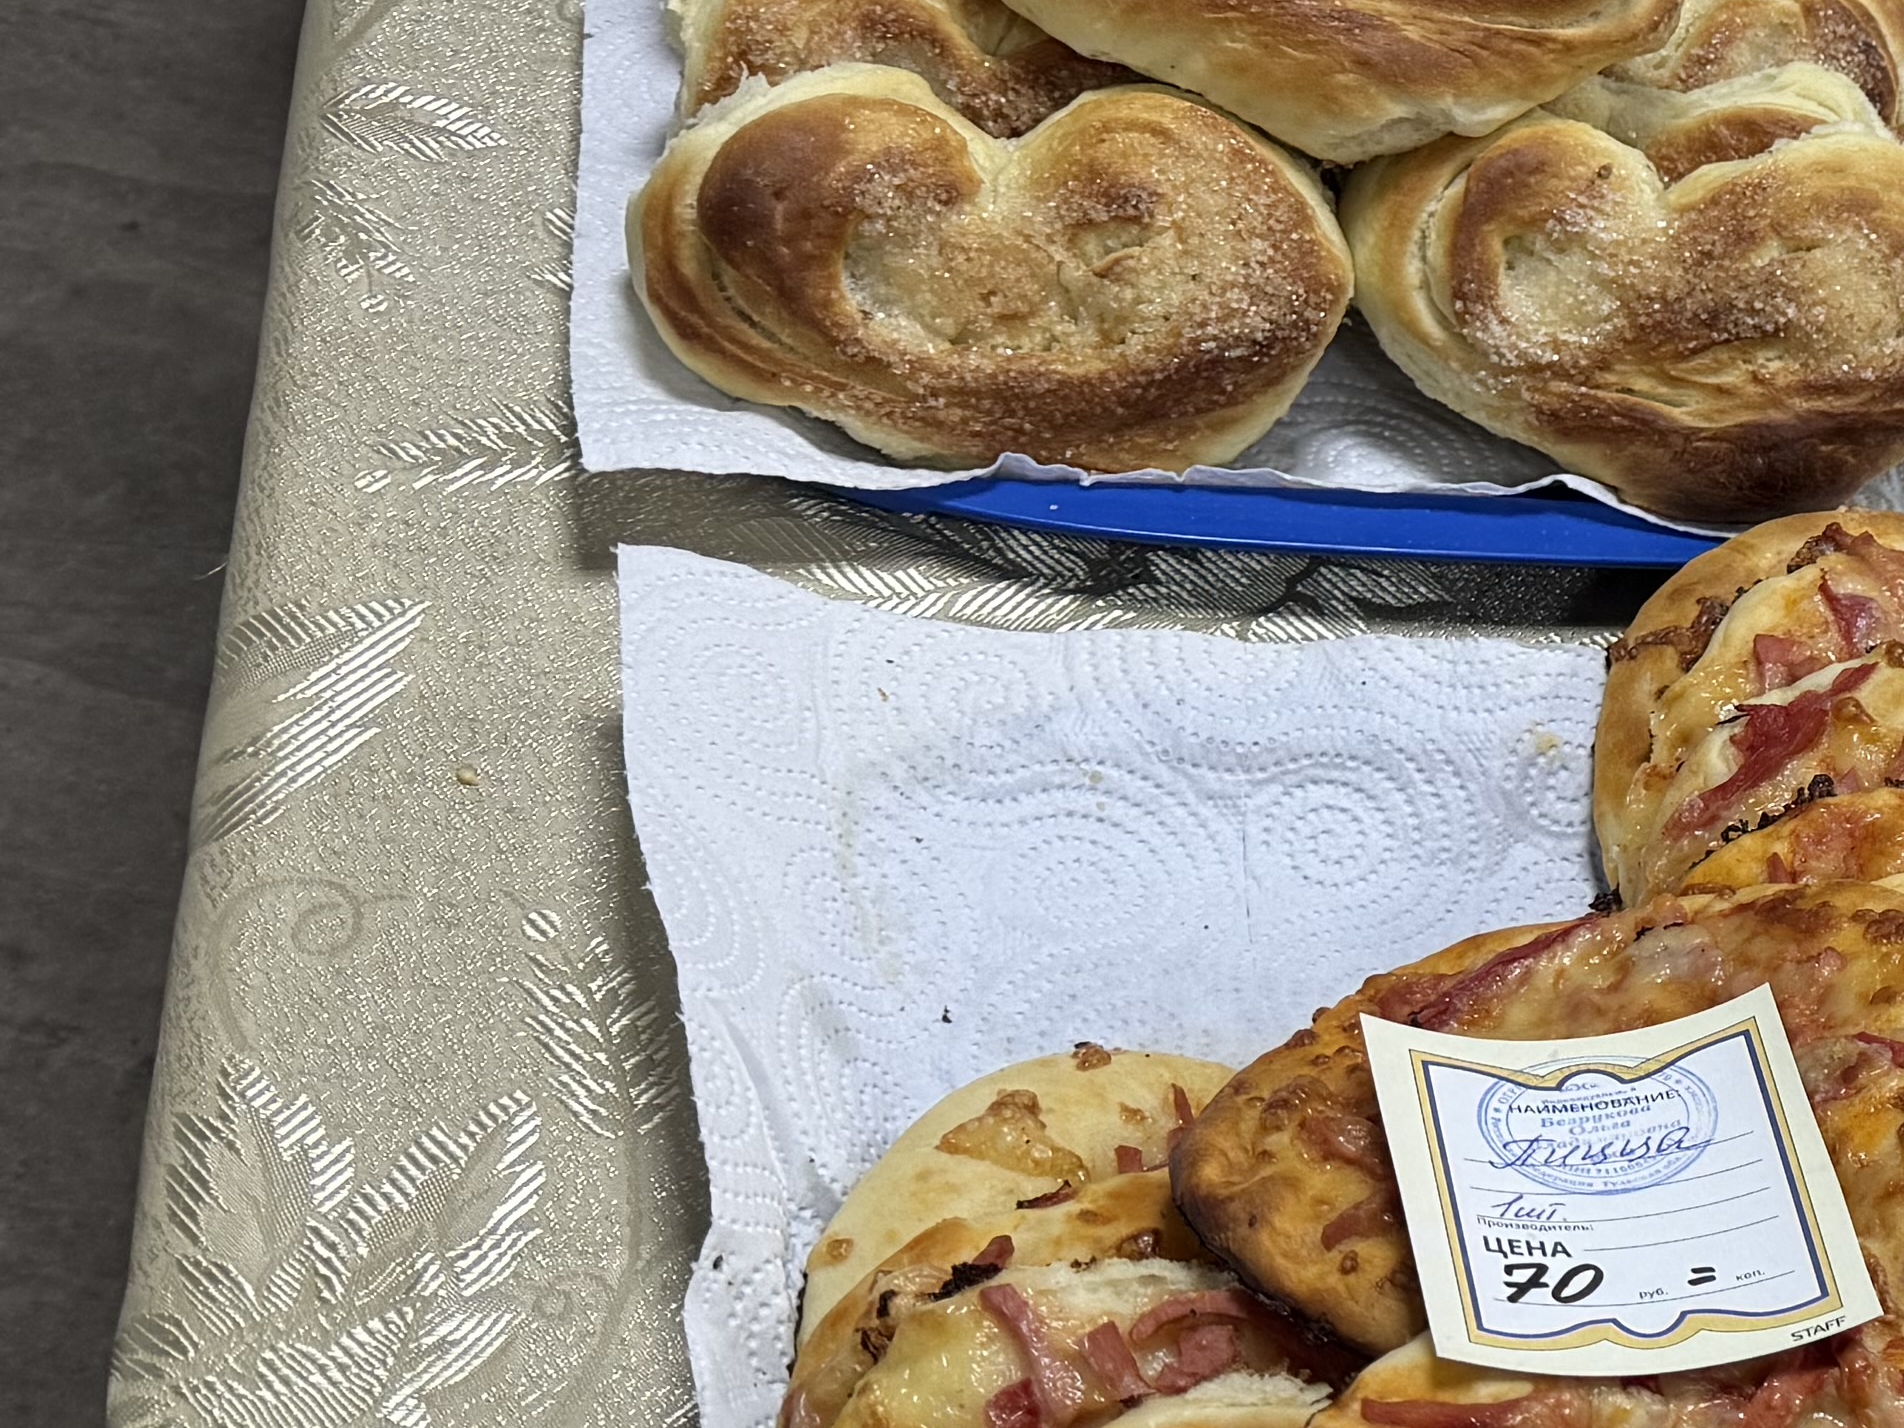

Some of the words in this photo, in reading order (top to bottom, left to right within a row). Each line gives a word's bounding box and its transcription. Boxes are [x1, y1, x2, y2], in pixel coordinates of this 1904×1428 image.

[1477, 1216, 1595, 1233] Производитель:
[1483, 1235, 1573, 1260] ЦЕНА
[1502, 1262, 1605, 1304] 70
[1638, 1287, 1669, 1302] руб.
[1735, 1269, 1766, 1283] коп.
[1790, 1314, 1847, 1343] STAFF
